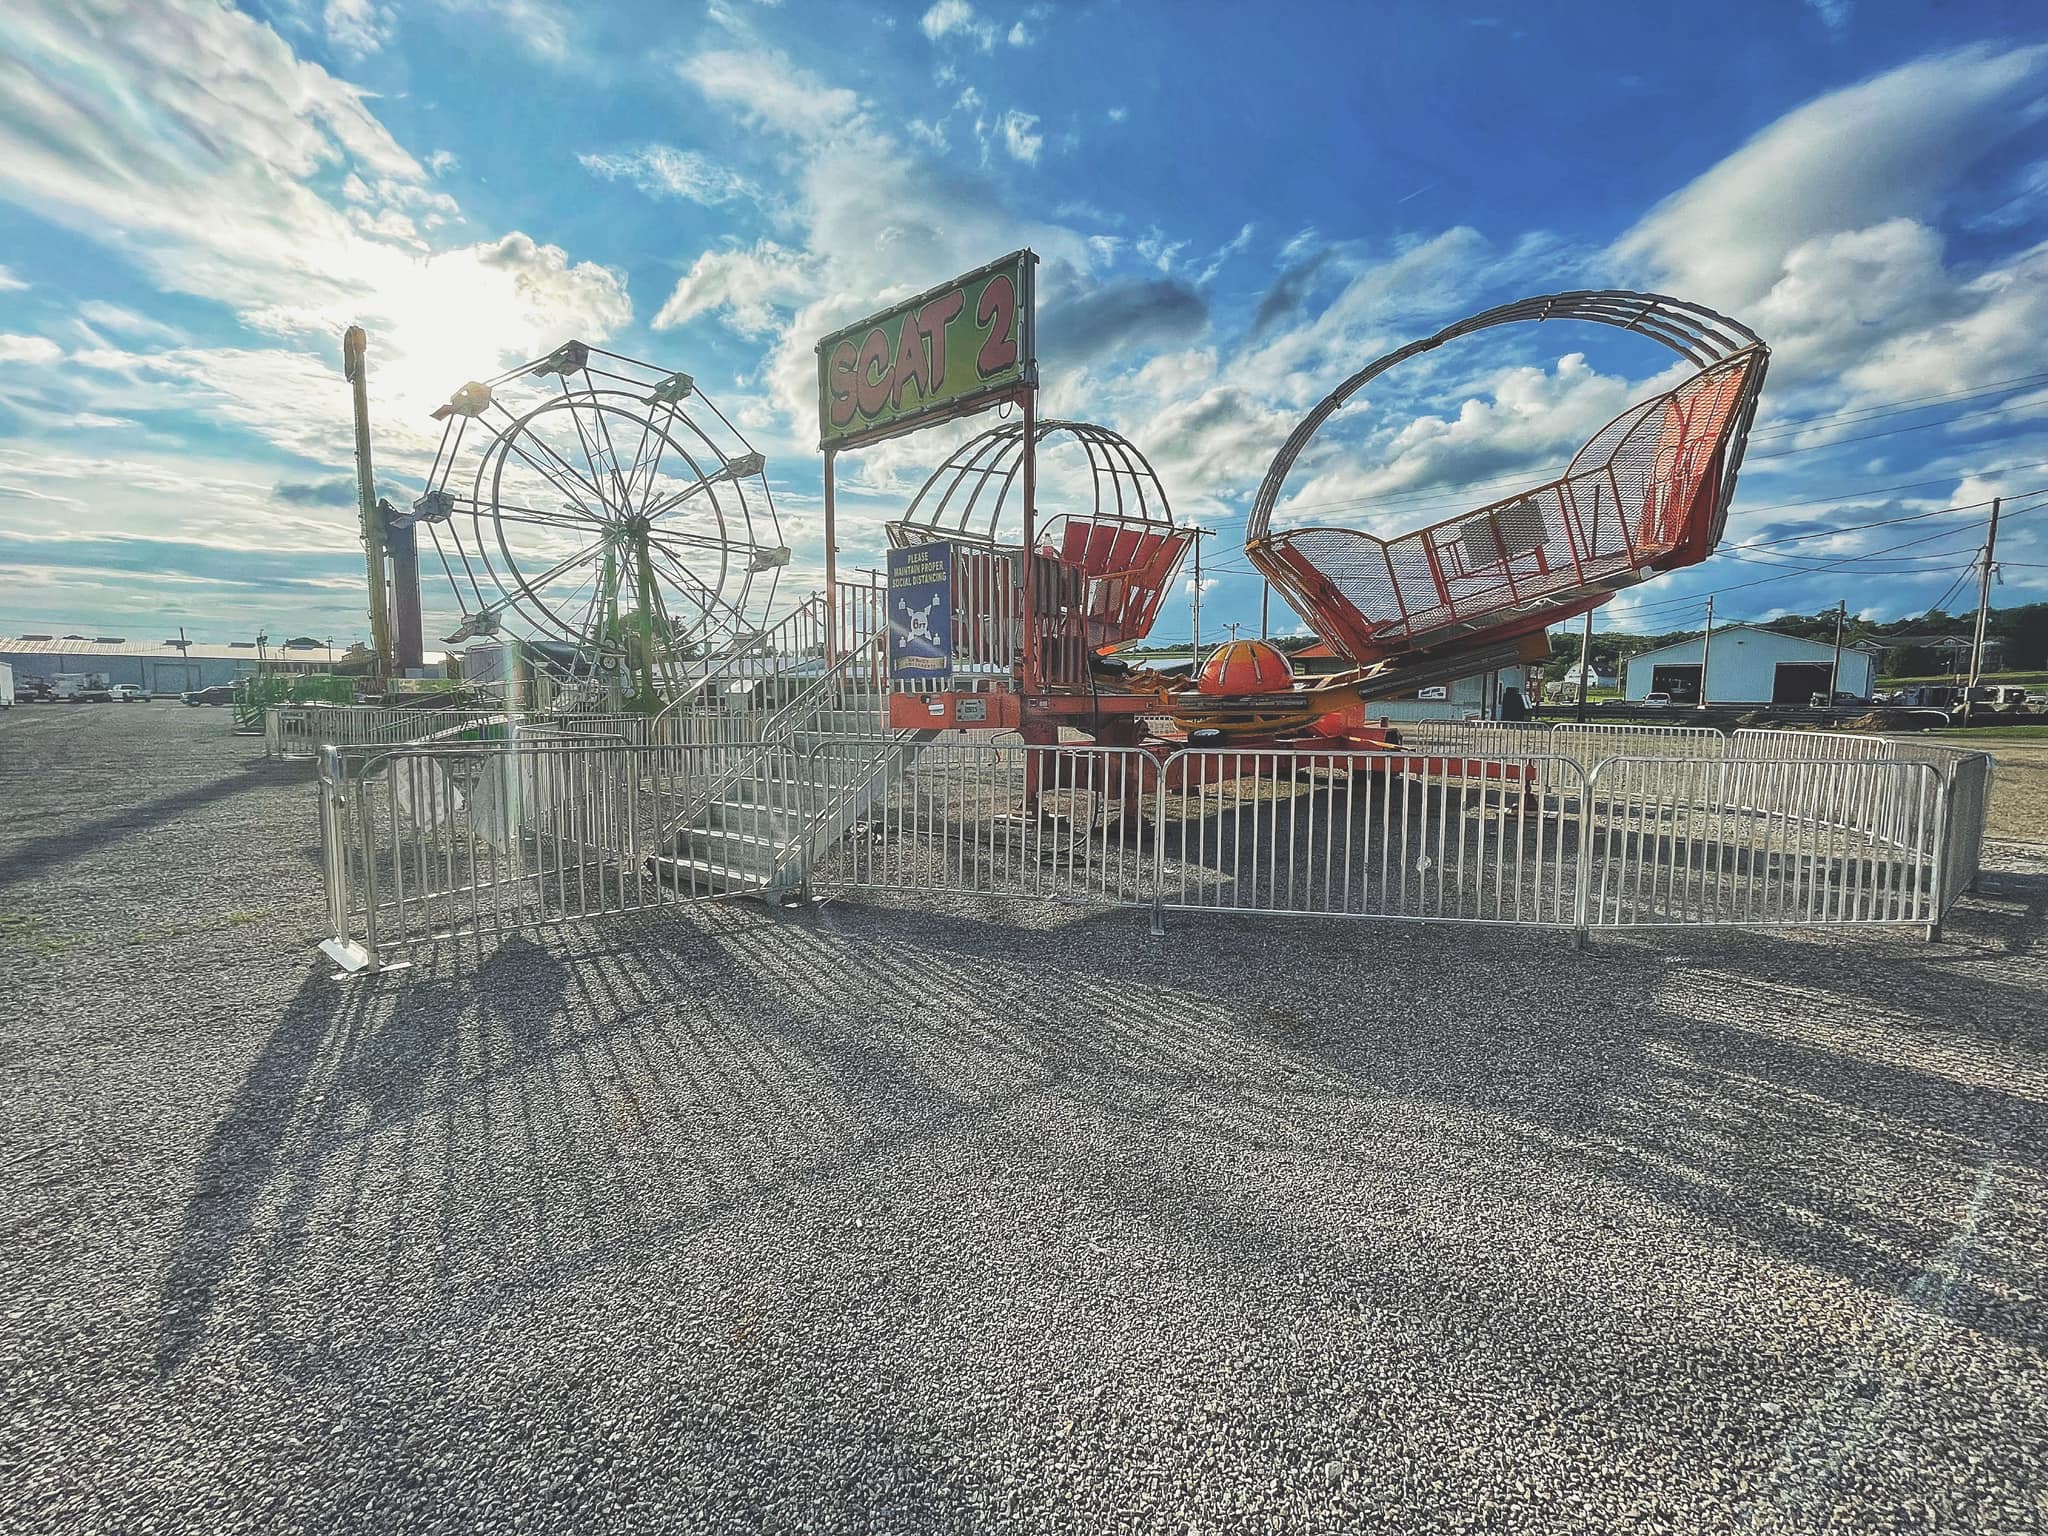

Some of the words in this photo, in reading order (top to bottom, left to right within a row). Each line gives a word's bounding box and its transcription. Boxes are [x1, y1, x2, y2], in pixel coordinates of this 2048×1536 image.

[829, 288, 965, 429] SCAT
[976, 274, 1018, 382] 2
[907, 551, 929, 564] PLEASE
[893, 564, 921, 577] MAINTAIN
[921, 560, 945, 573] PROPER
[892, 577, 912, 588] SOCIAL
[912, 571, 947, 585] DISTANCING
